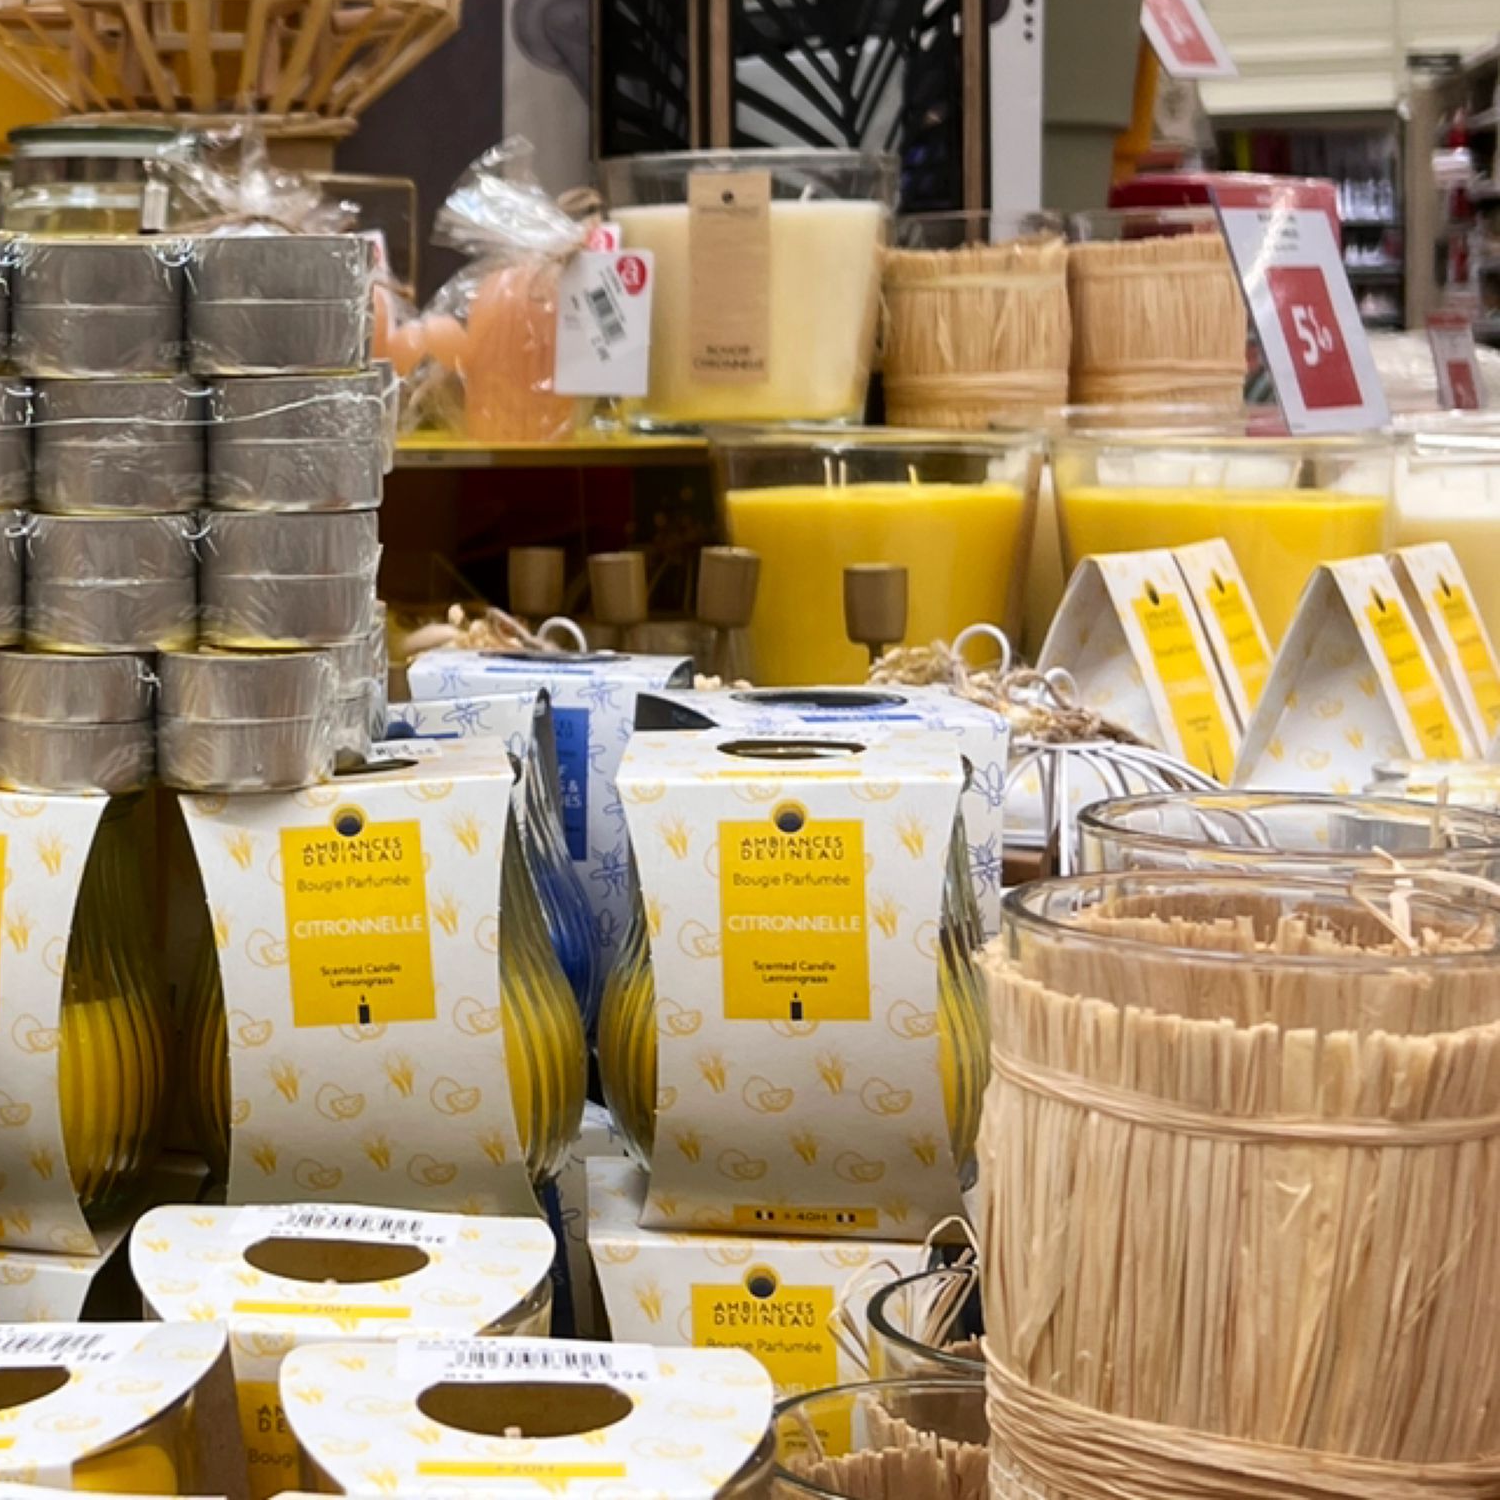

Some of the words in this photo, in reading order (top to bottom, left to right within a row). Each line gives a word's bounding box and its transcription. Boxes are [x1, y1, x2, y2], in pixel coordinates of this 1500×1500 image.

[303, 837, 402, 853] AMBIANCES
[741, 836, 843, 848] AMBIANCES
[303, 850, 403, 866] DEVINEAU
[741, 849, 844, 860] DEVINEAU
[296, 879, 343, 893] Bougie
[733, 873, 781, 888] Bougie
[784, 873, 850, 886] Parfumée
[293, 914, 423, 939] CITRONNELLE
[728, 915, 861, 932] CITRONNELLE
[753, 961, 796, 971] Scented
[799, 961, 836, 971] Candle
[713, 1301, 814, 1315] AMBIANCES
[714, 1313, 815, 1327] DEVINEAU
